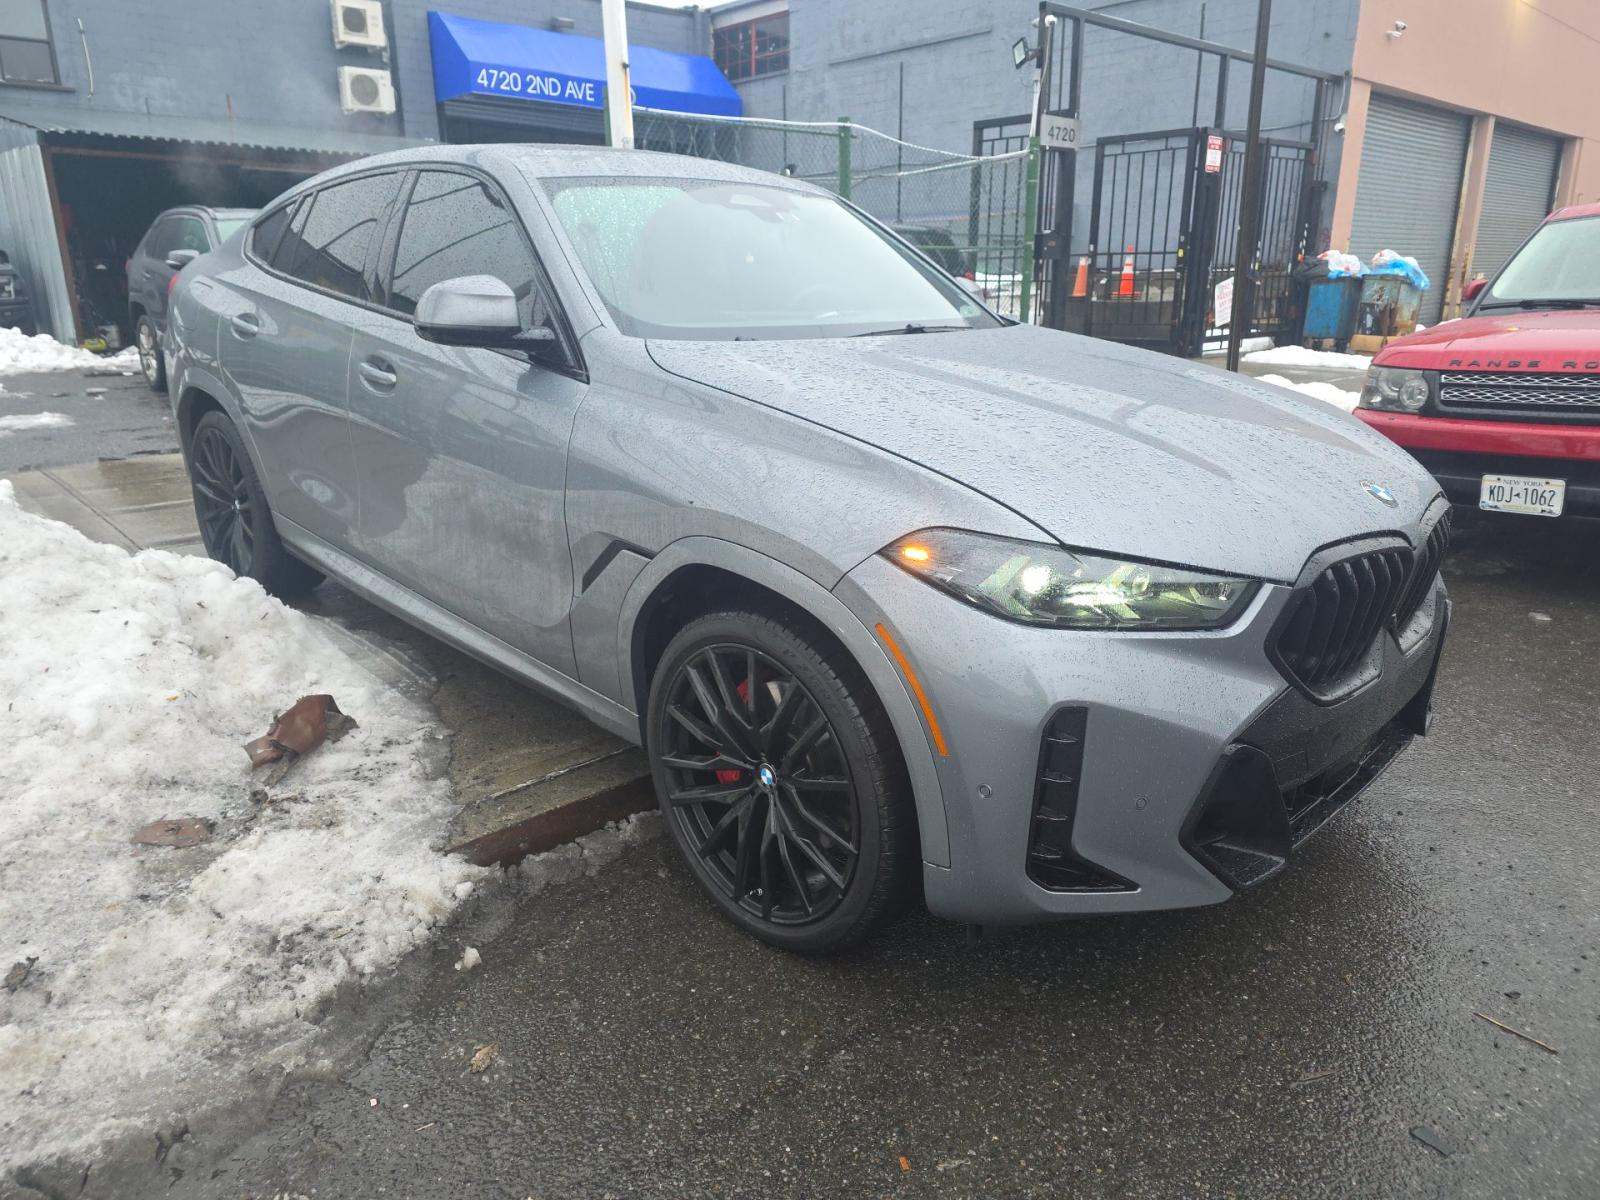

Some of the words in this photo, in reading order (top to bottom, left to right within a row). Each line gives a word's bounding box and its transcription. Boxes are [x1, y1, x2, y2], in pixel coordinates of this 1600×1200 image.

[476, 68, 522, 92] 4720
[526, 74, 562, 96] 2ND
[564, 80, 595, 102] AVE
[1047, 125, 1076, 143] 4720
[1449, 359, 1541, 369] RANGE
